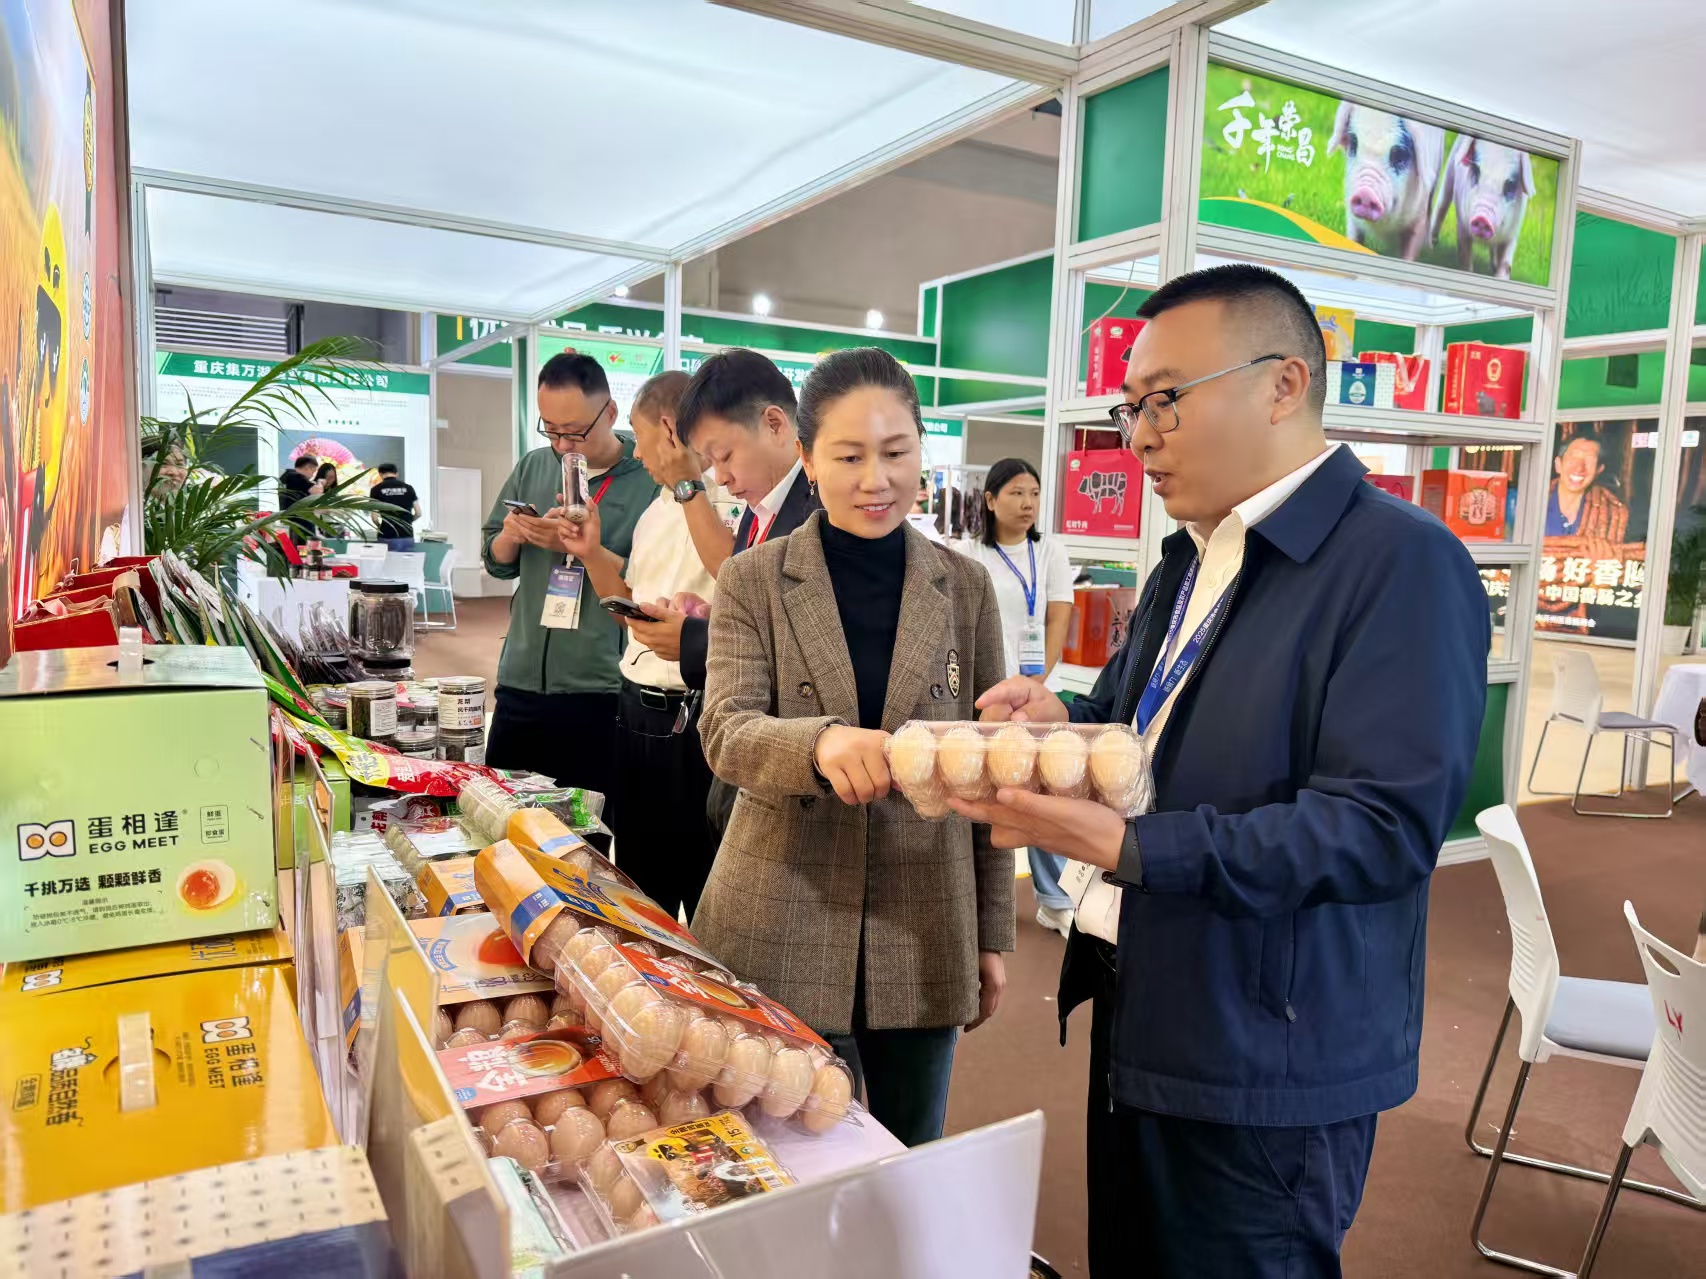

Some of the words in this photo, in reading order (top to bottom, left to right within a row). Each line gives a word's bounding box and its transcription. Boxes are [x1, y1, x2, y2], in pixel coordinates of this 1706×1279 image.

[87, 810, 180, 840] 蛋相逢
[89, 840, 127, 854] EGG
[132, 835, 180, 850] MEET
[24, 877, 91, 898] 千挑万选
[97, 868, 162, 890] 颗颗鲜香
[203, 1047, 220, 1067] EGG
[206, 1067, 226, 1089] MEET
